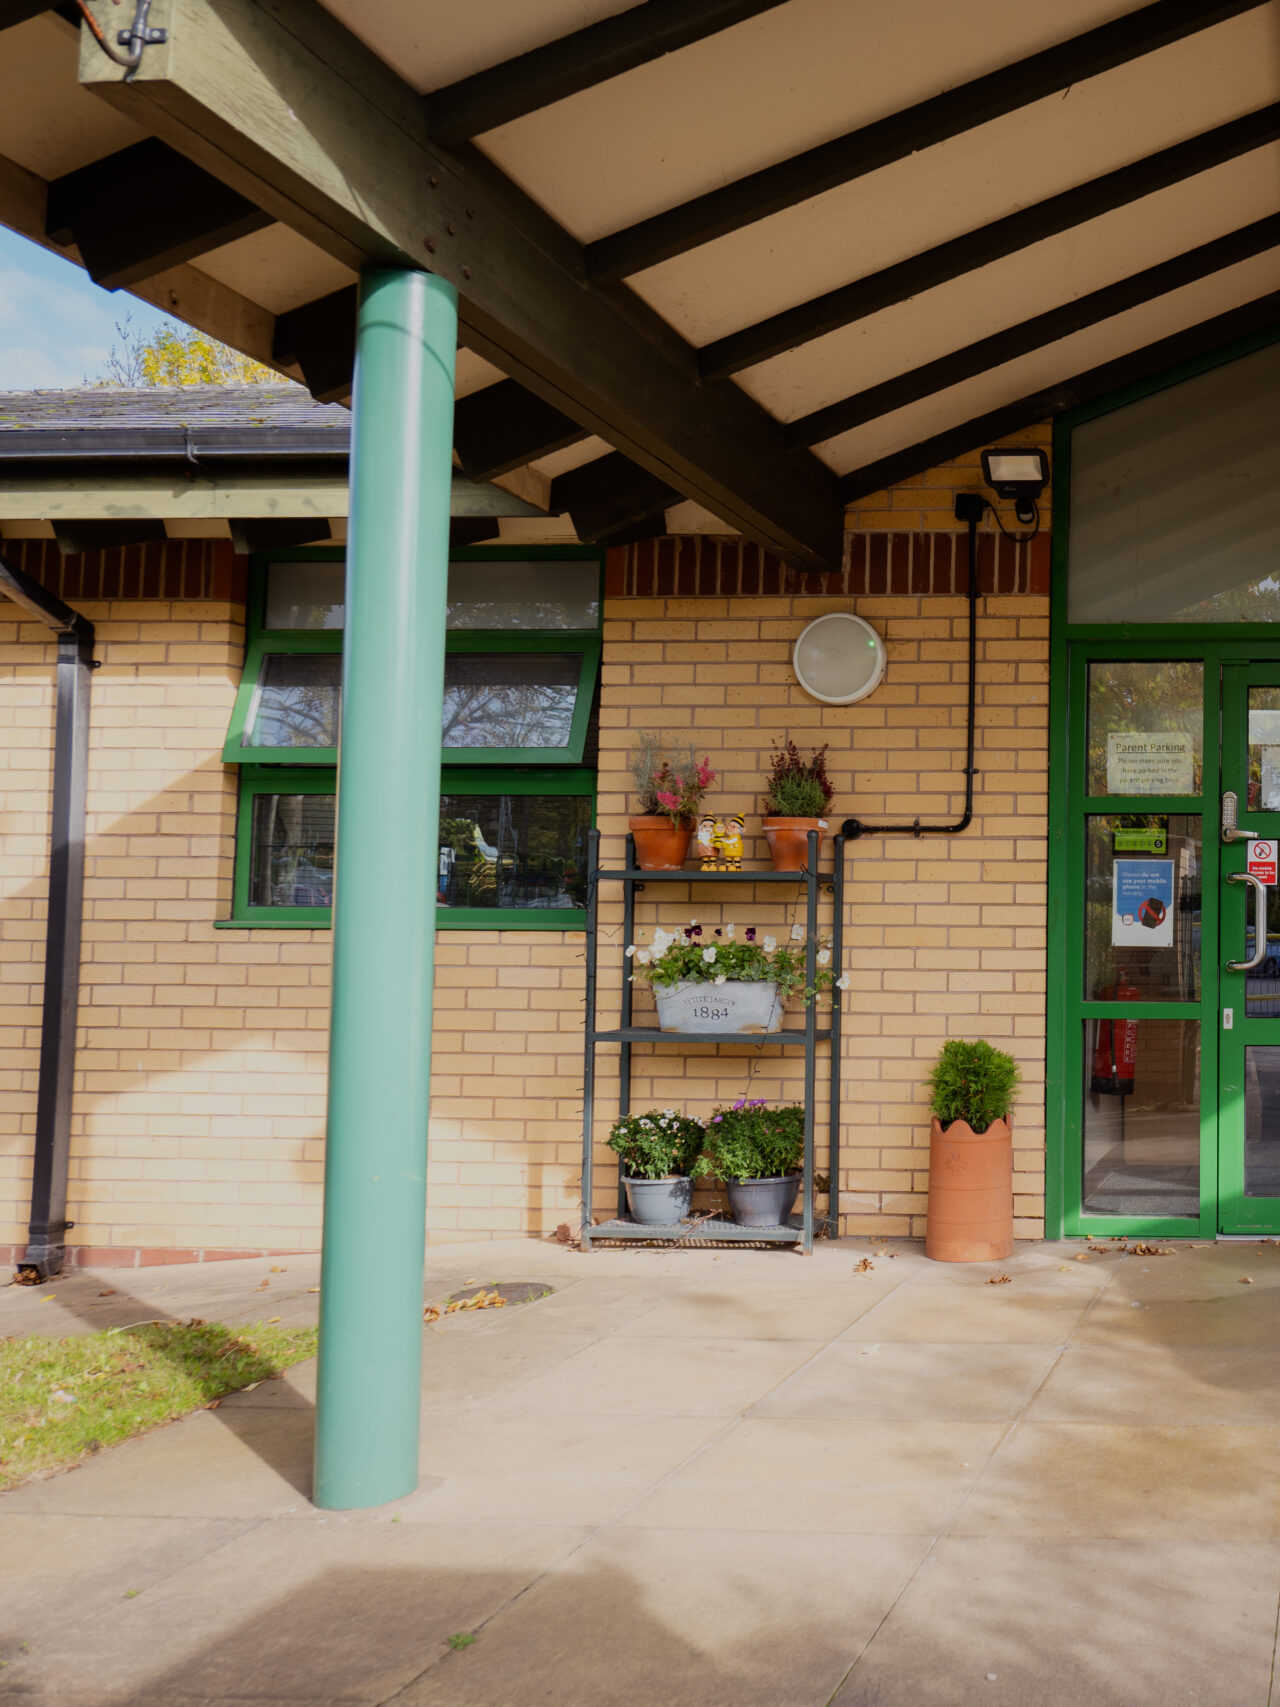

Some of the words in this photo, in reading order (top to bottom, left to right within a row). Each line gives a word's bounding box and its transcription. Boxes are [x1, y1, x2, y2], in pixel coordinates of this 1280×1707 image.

[1116, 743, 1147, 752] Parent
[1150, 743, 1186, 753] Parking
[1138, 767, 1160, 775] parked
[710, 996, 737, 1007] JARDIN
[693, 1006, 729, 1021] 1884
